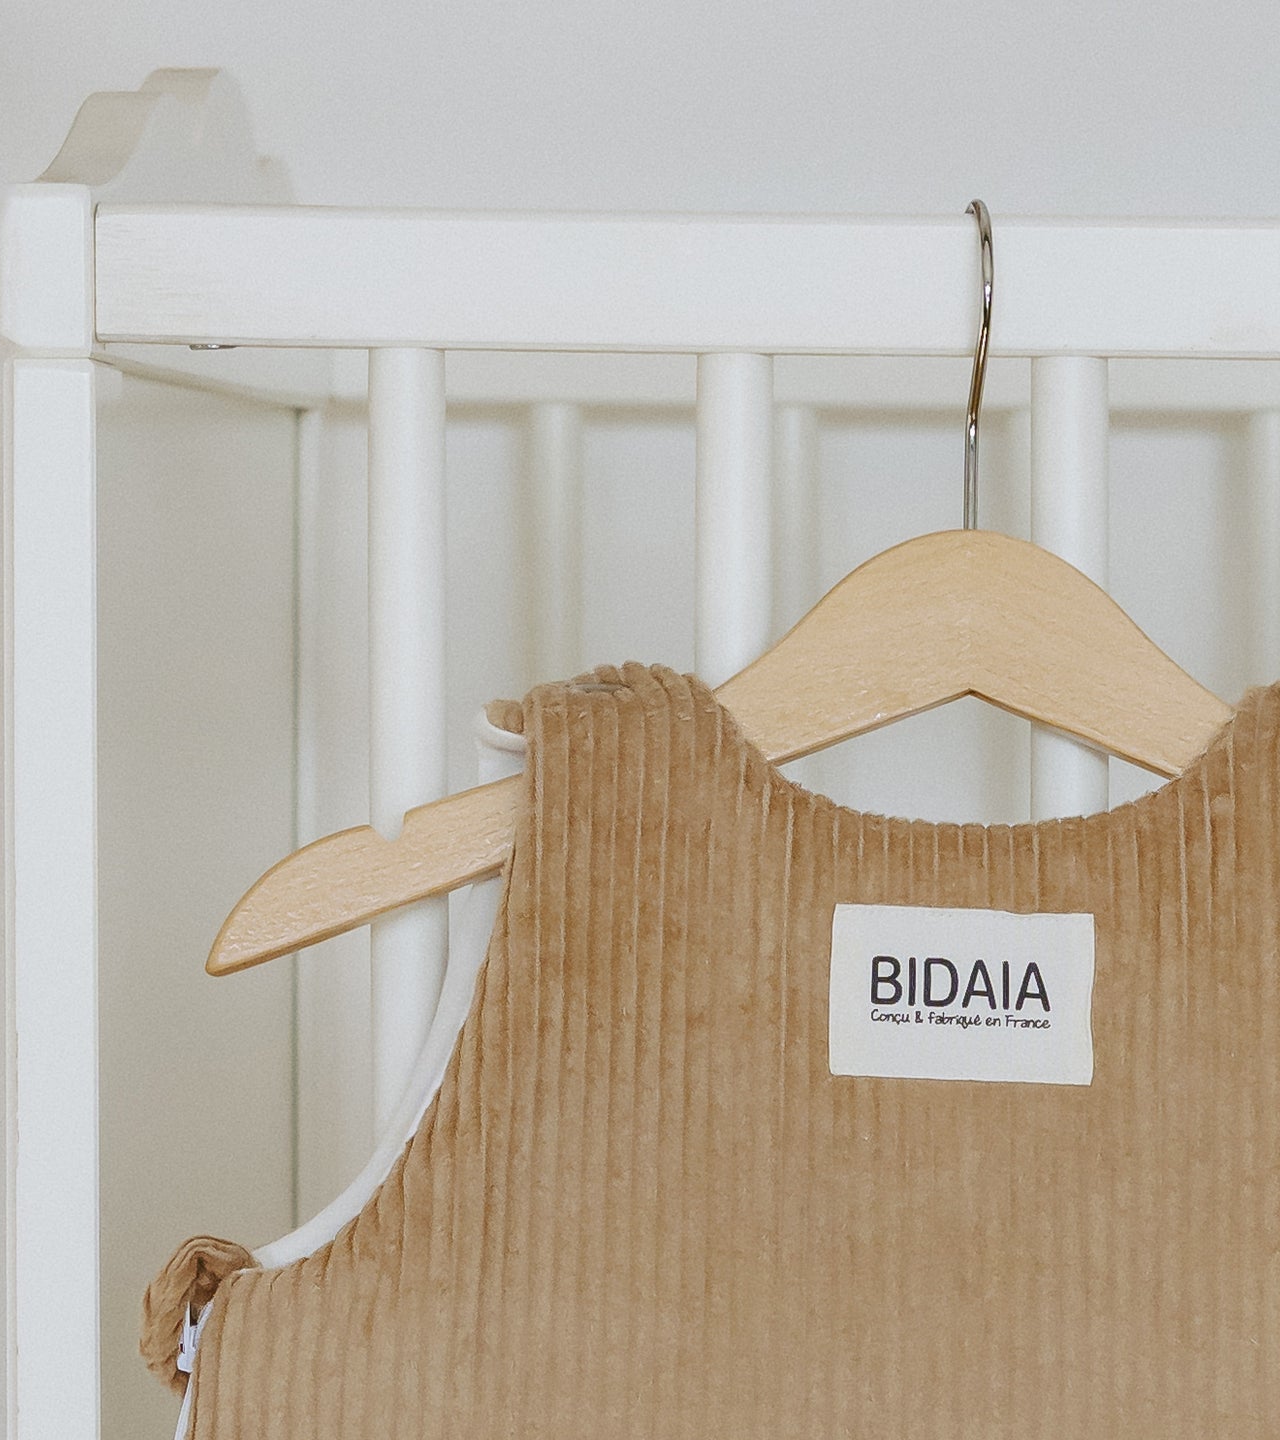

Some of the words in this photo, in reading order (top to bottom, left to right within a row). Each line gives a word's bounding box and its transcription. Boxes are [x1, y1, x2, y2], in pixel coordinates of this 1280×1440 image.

[870, 955, 1051, 1012] BIDAIA
[870, 1008, 910, 1026] Conçu
[914, 1010, 924, 1024] &
[928, 1011, 982, 1030] fabriqué
[985, 1016, 1002, 1028] en
[1005, 1014, 1051, 1030] France
